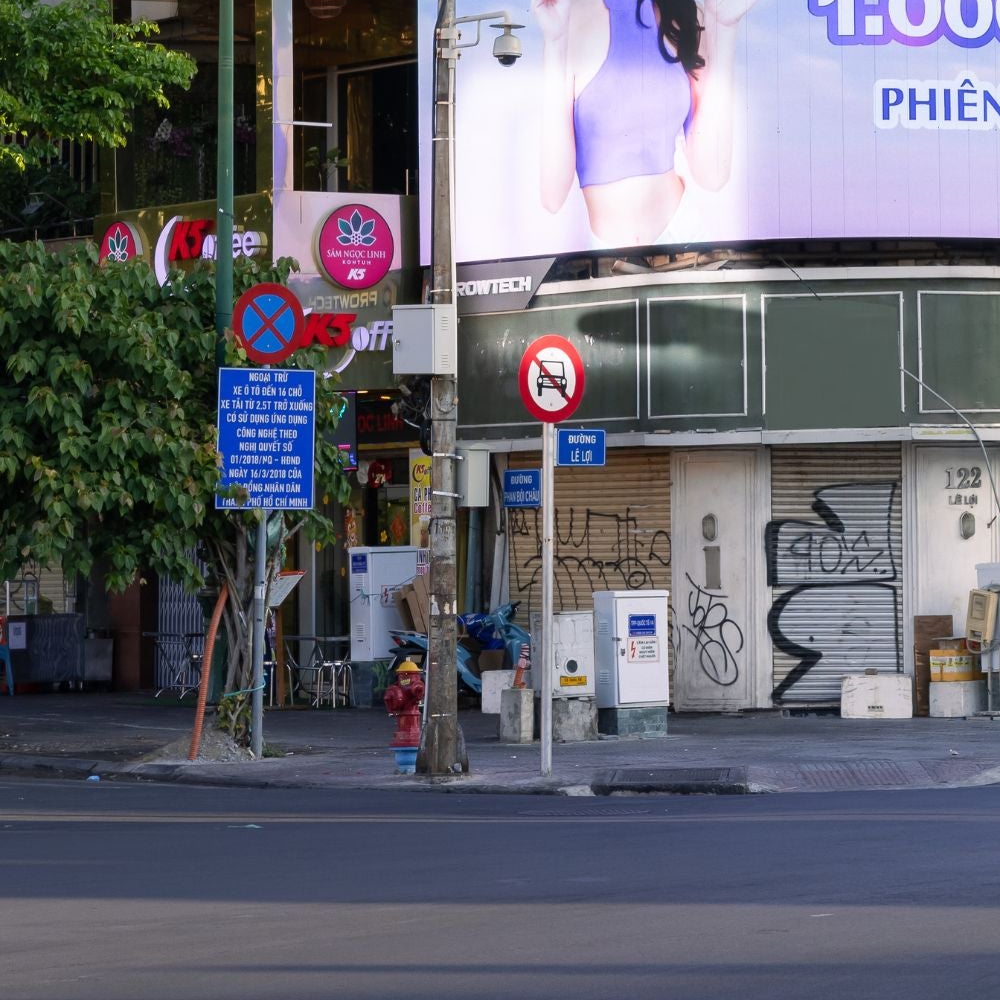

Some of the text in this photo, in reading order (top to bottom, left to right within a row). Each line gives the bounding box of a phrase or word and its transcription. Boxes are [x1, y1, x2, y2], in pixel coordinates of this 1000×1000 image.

[168, 219, 215, 261] K5
[367, 250, 386, 259] LINH
[347, 268, 366, 280] K5
[456, 276, 532, 296] ROWTECH
[300, 313, 357, 348] K5
[233, 386, 242, 395] XE
[251, 384, 260, 396] TÔ
[278, 387, 286, 397] 16
[220, 400, 230, 409] XE
[256, 401, 271, 410] 2.5T
[226, 411, 236, 423] CÓ
[236, 427, 256, 438] CÔNG
[279, 430, 298, 439] THEO
[568, 433, 596, 444] ĐƯỜNG
[571, 448, 593, 464] LÊ LỢI
[229, 466, 248, 478] NGÀY
[251, 469, 286, 479] 16/3/2018
[945, 467, 982, 489] 122
[275, 495, 287, 507] CHÍ
[289, 498, 308, 507] MINH
